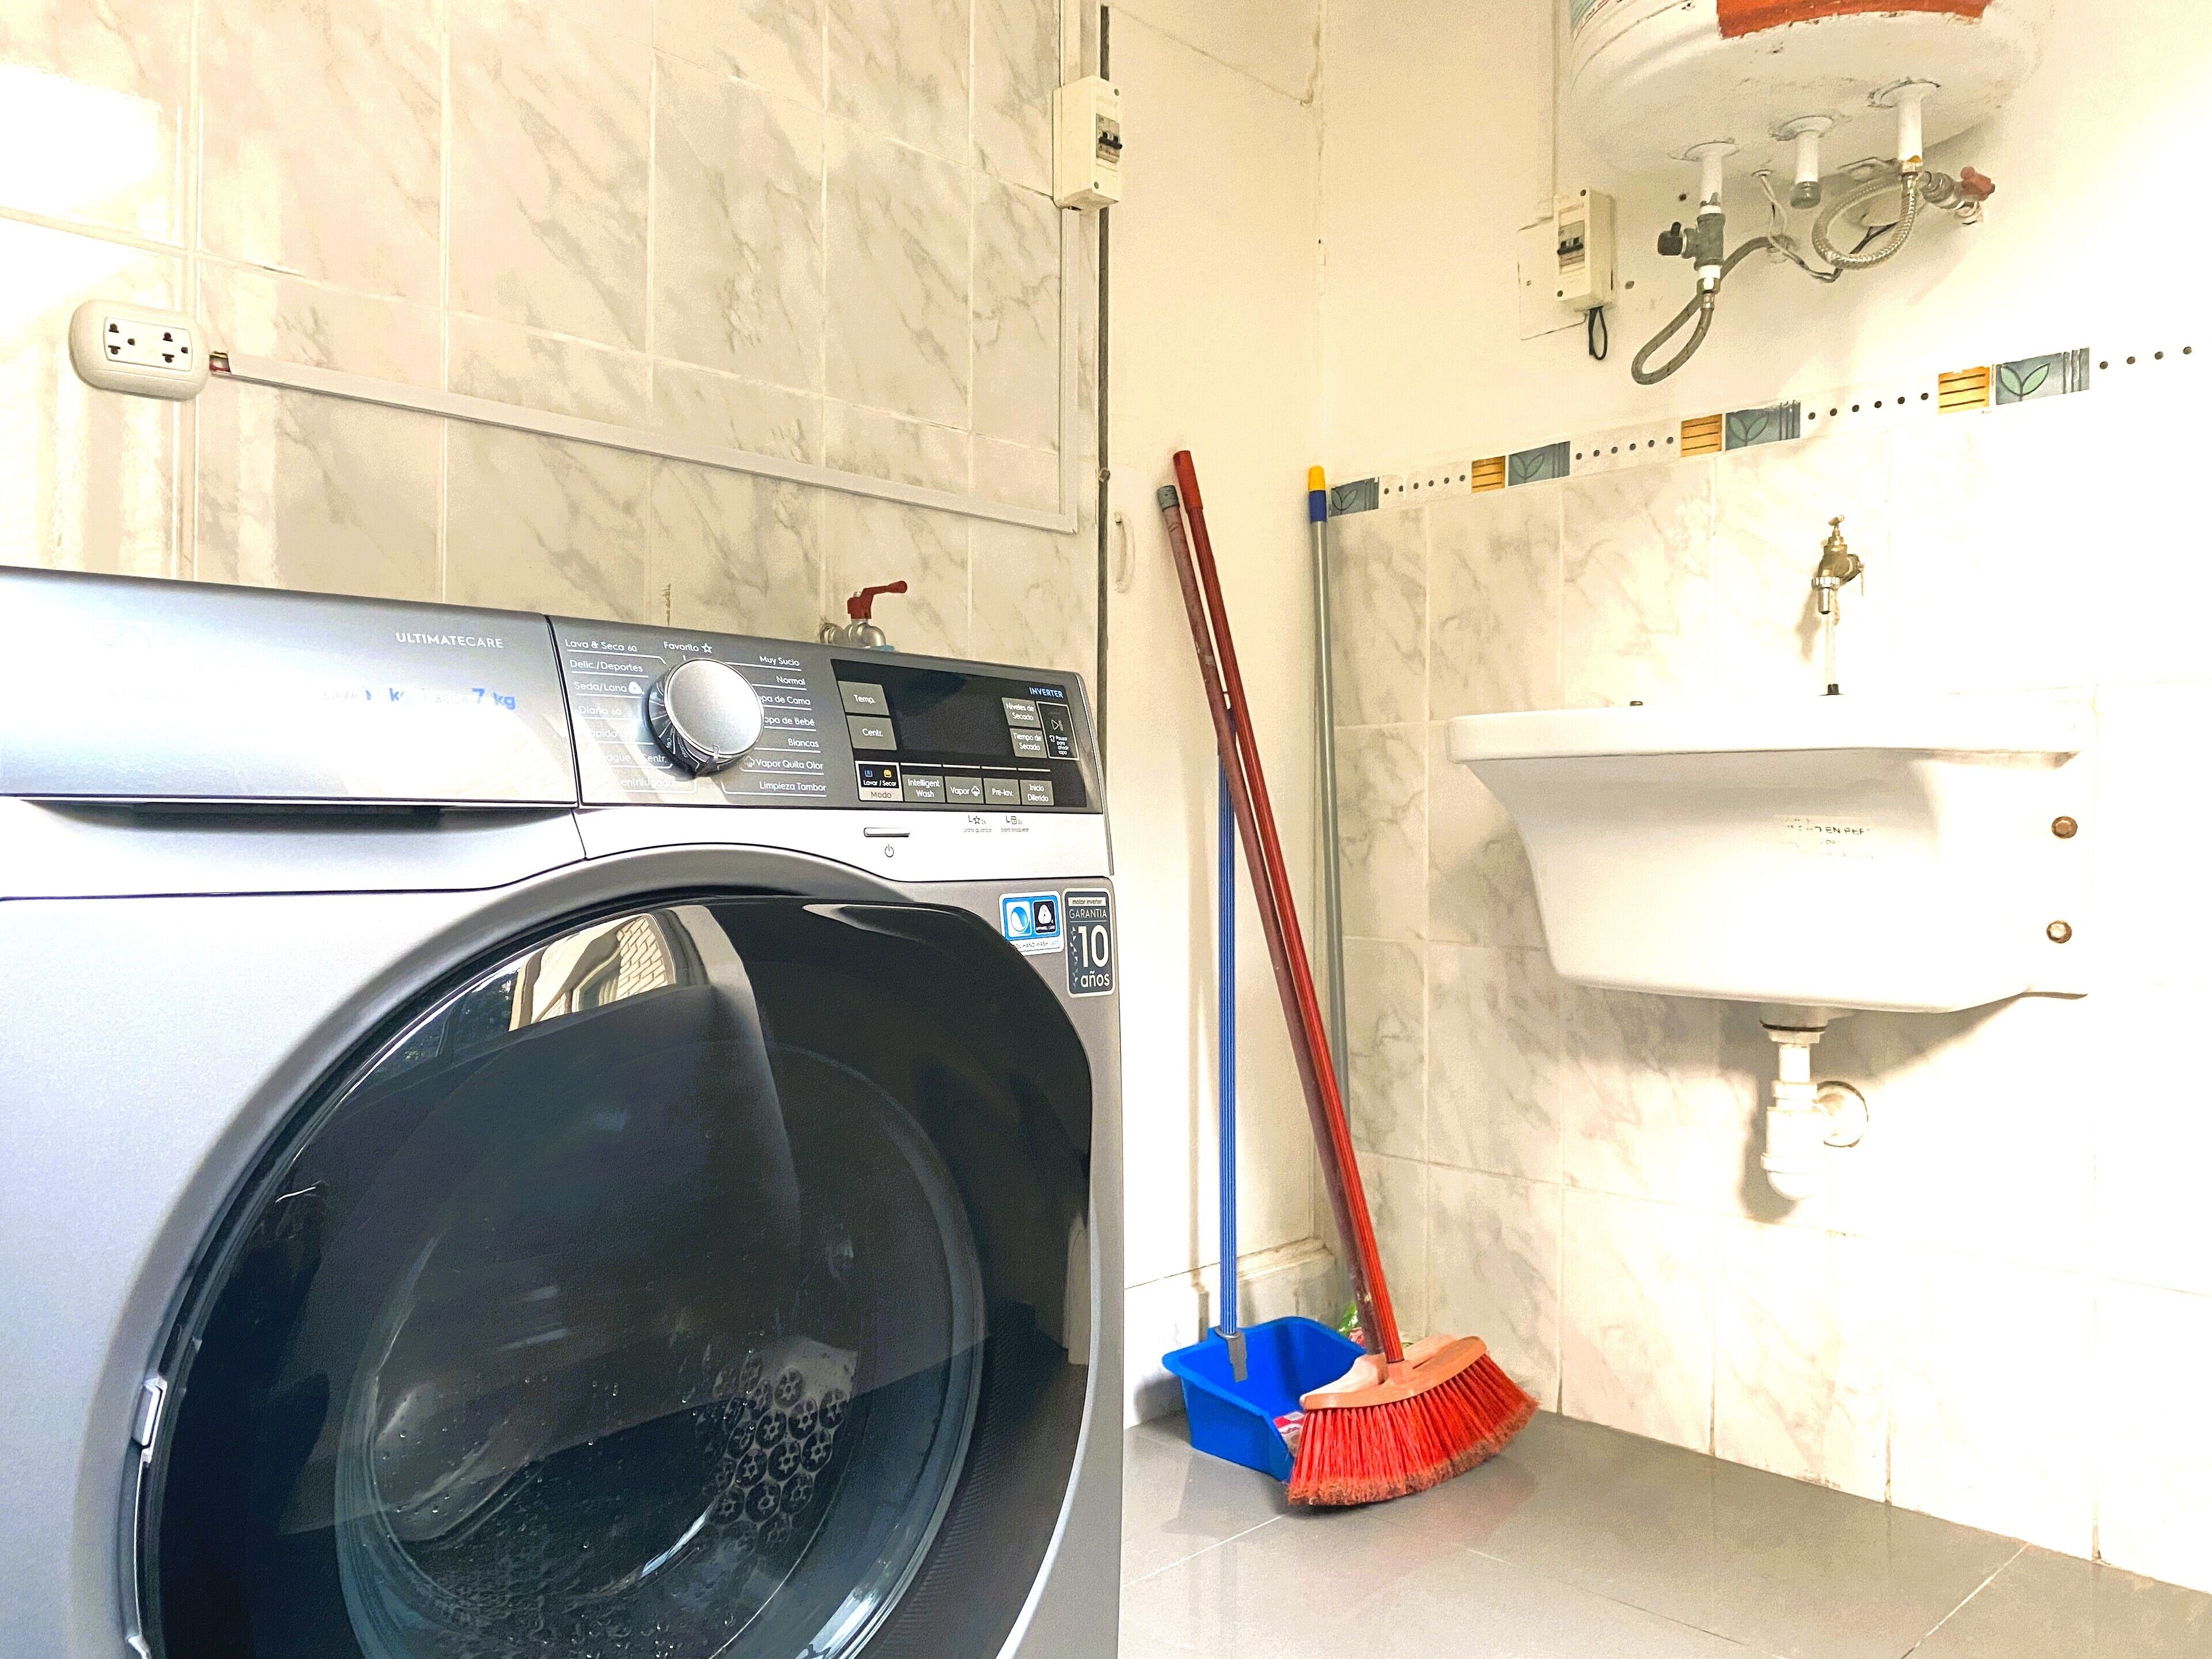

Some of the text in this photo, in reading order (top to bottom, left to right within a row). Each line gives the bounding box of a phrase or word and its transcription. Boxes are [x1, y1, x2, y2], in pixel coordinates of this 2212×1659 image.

[395, 632, 503, 648] ULTIMATECARE
[565, 639, 589, 649] Lava
[591, 641, 599, 649] &
[601, 641, 625, 651] Seca
[664, 641, 699, 652] Favorito
[760, 656, 800, 666] Muy Sucio
[776, 676, 805, 685] Normal
[574, 681, 627, 692] Seda/Lana
[1029, 687, 1063, 698] INVERTER
[472, 688, 485, 704] 7
[493, 692, 516, 710] kg
[775, 695, 785, 703] de
[787, 696, 811, 706] Cama
[853, 694, 876, 704] Temp.
[1005, 703, 1026, 711] Niveles
[782, 717, 793, 725] de
[794, 717, 815, 726] Bebé
[1012, 712, 1033, 721] Secado
[862, 728, 884, 737] Centr.
[1013, 732, 1033, 741] Tiempo
[787, 738, 819, 747] Blancas
[1019, 742, 1040, 751] Secado
[756, 759, 823, 769] Vapor Quita Olor
[759, 781, 826, 791] Limpieza Tambor
[907, 779, 940, 789] Intelligent
[1029, 783, 1044, 791] Inicio
[915, 789, 934, 798] Wash
[950, 786, 970, 796] Vapor
[1027, 793, 1049, 802] Diferido
[1069, 908, 1107, 919] GARANTIA
[1078, 925, 1109, 968] 10
[1080, 970, 1110, 988] años
